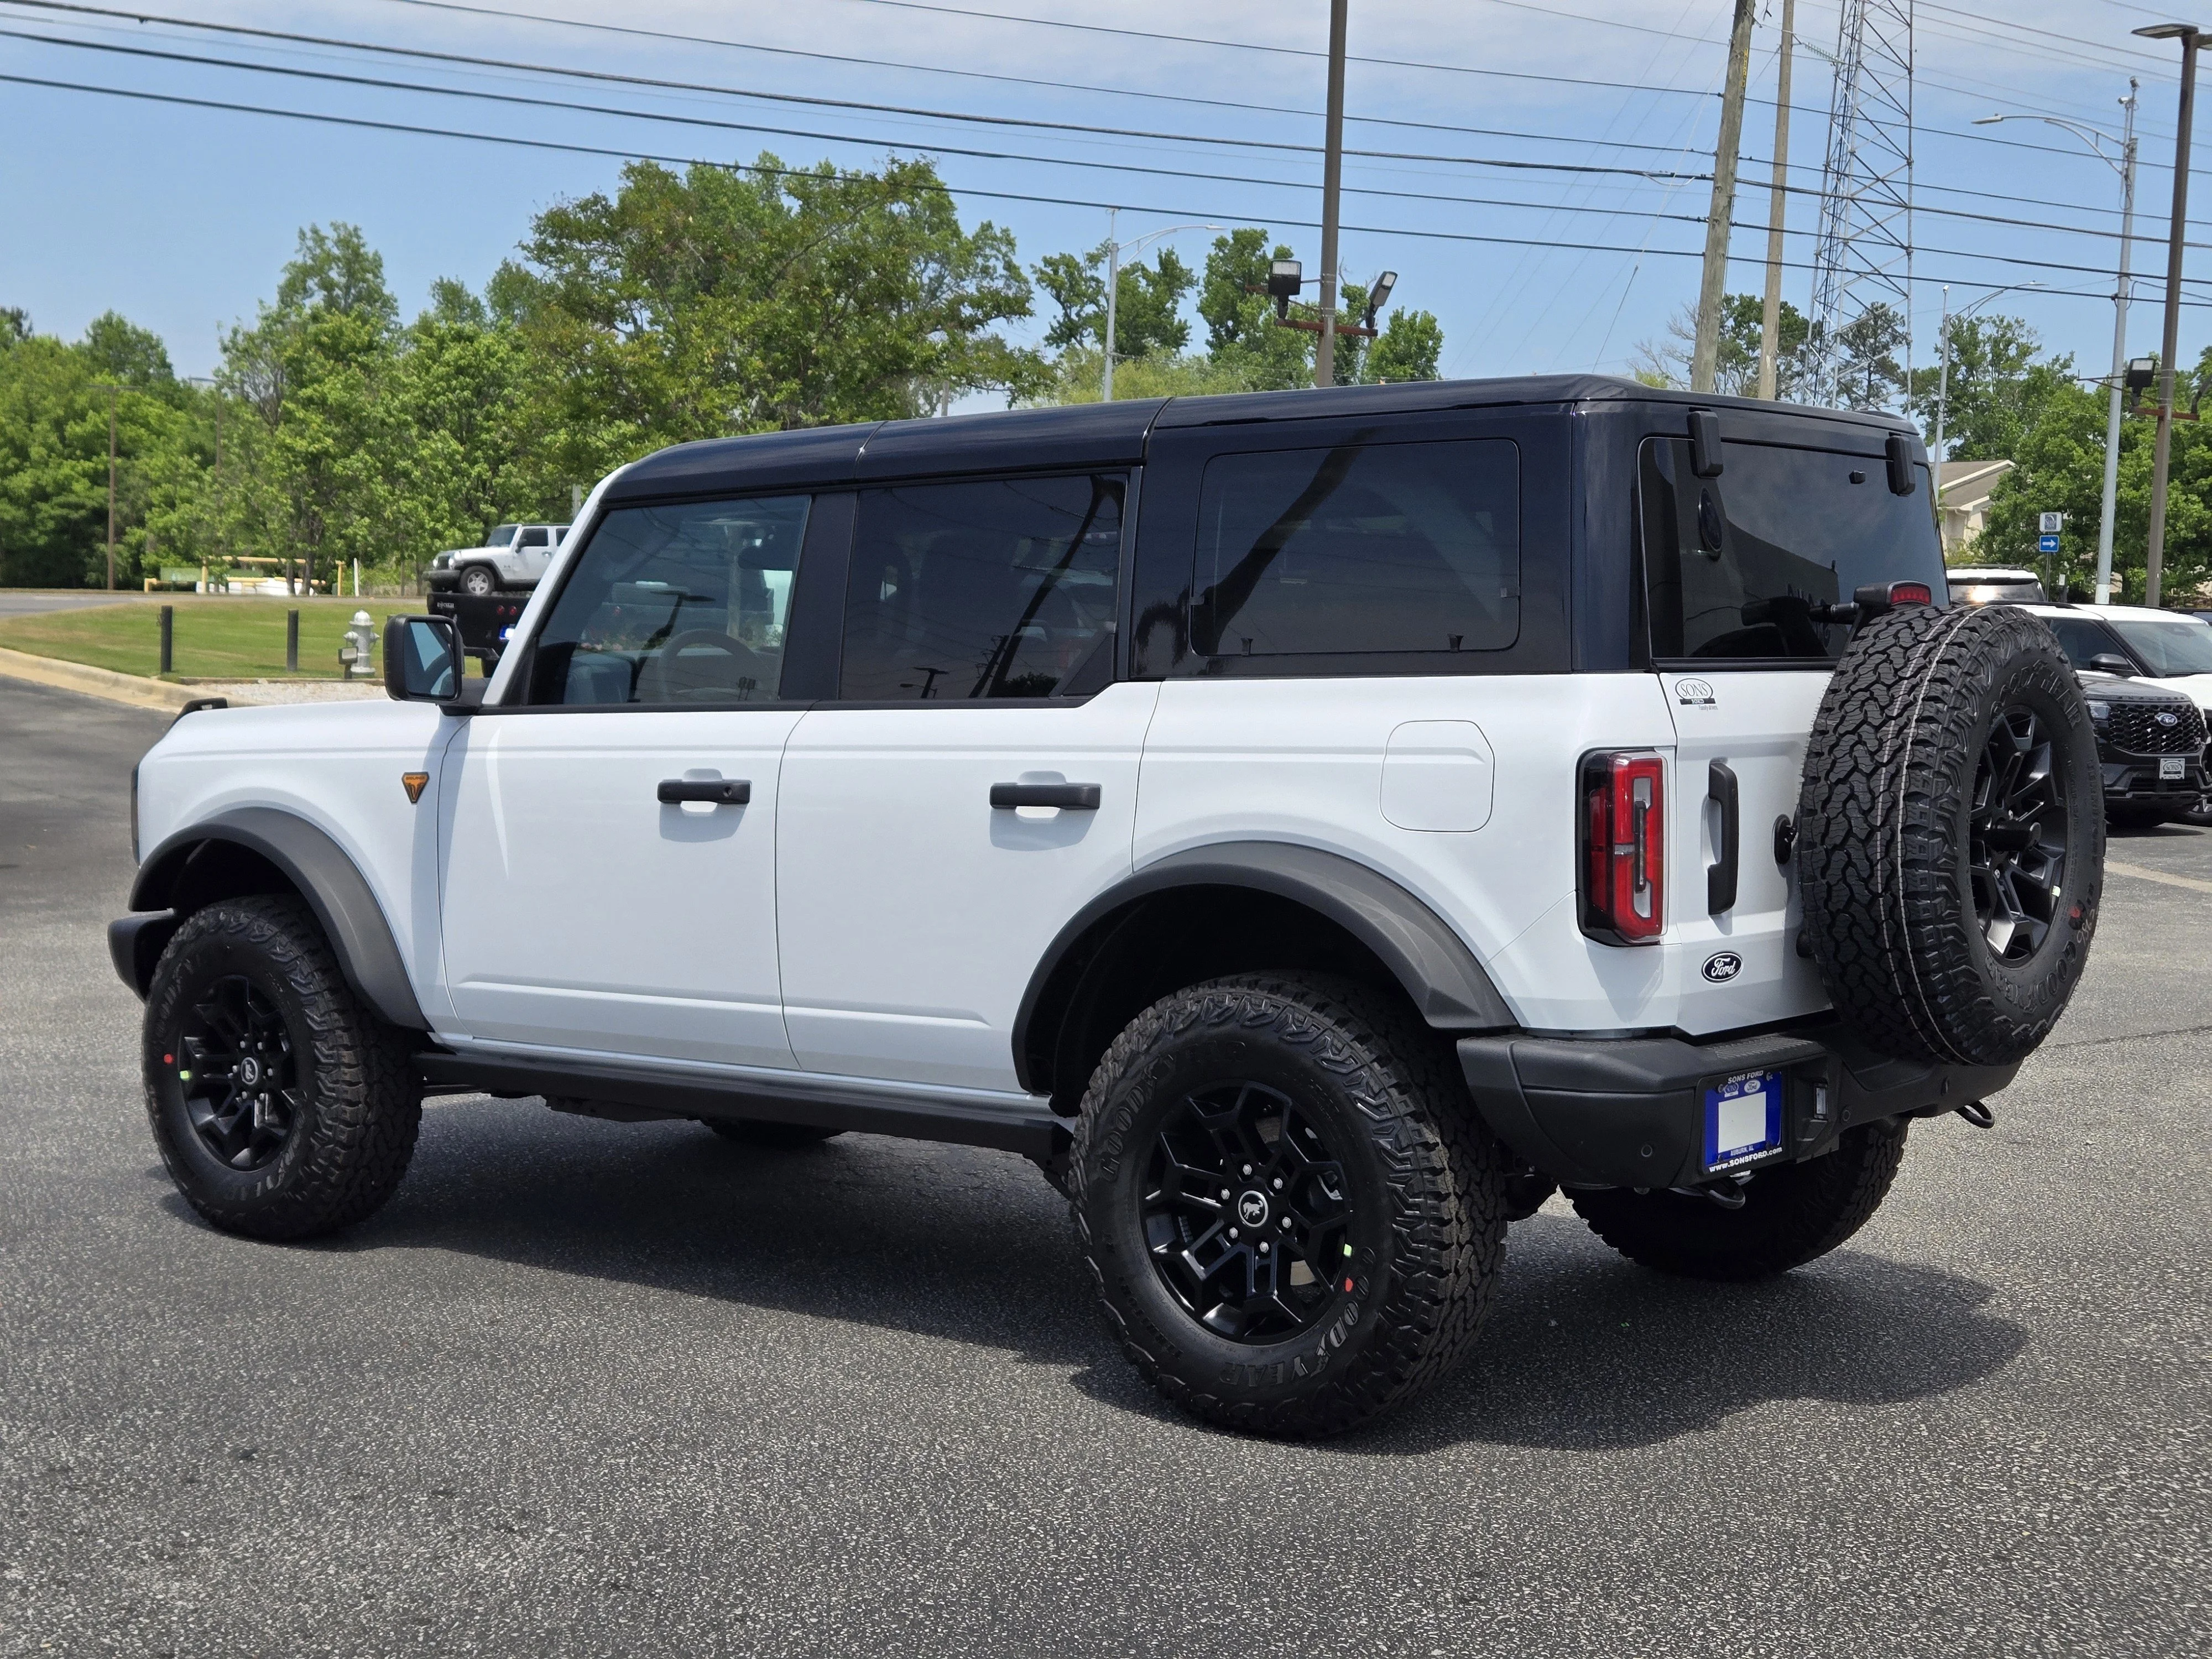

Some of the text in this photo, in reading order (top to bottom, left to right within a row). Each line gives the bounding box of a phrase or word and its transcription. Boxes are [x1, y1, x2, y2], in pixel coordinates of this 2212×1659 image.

[1681, 684, 1708, 697] SONS
[1711, 957, 1736, 977] Ford
[1728, 1070, 1764, 1084] SONS FORD
